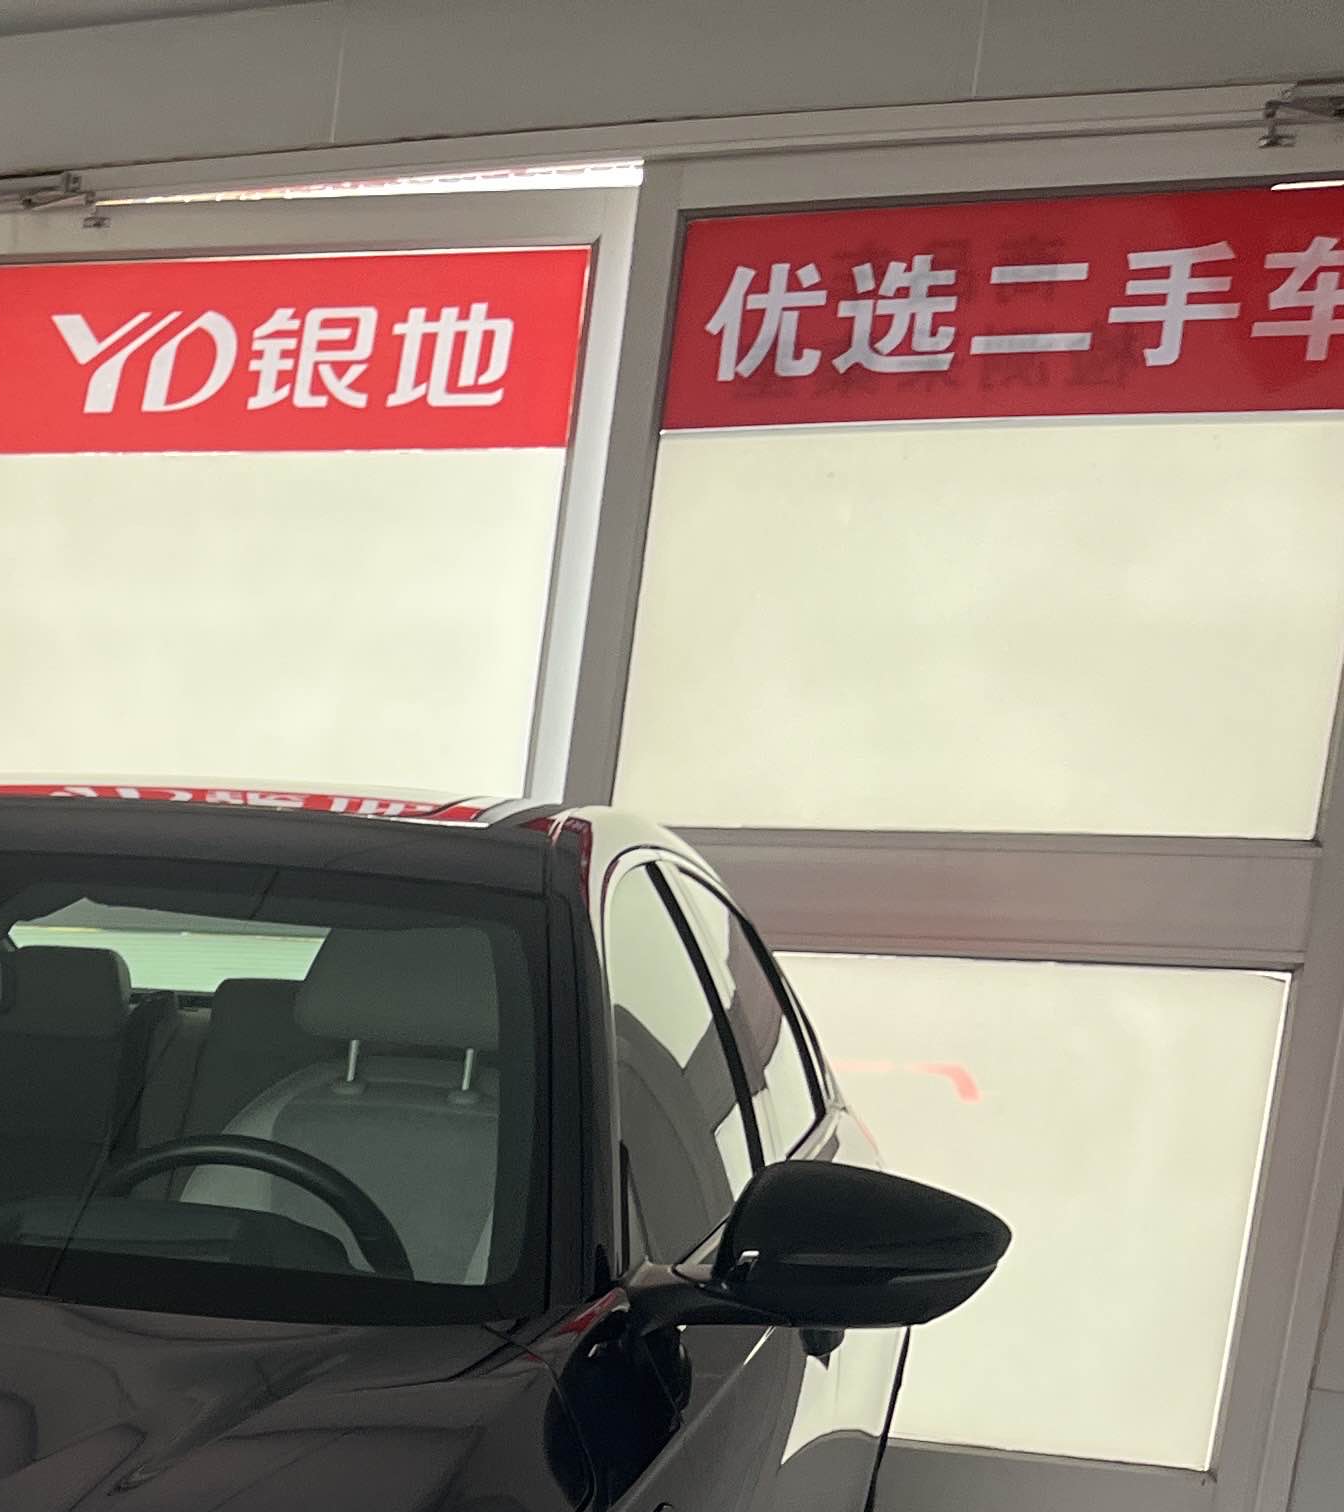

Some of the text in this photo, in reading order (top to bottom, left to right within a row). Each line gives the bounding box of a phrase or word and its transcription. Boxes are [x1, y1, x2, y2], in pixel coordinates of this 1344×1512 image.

[705, 235, 1344, 382] 优选二手车
